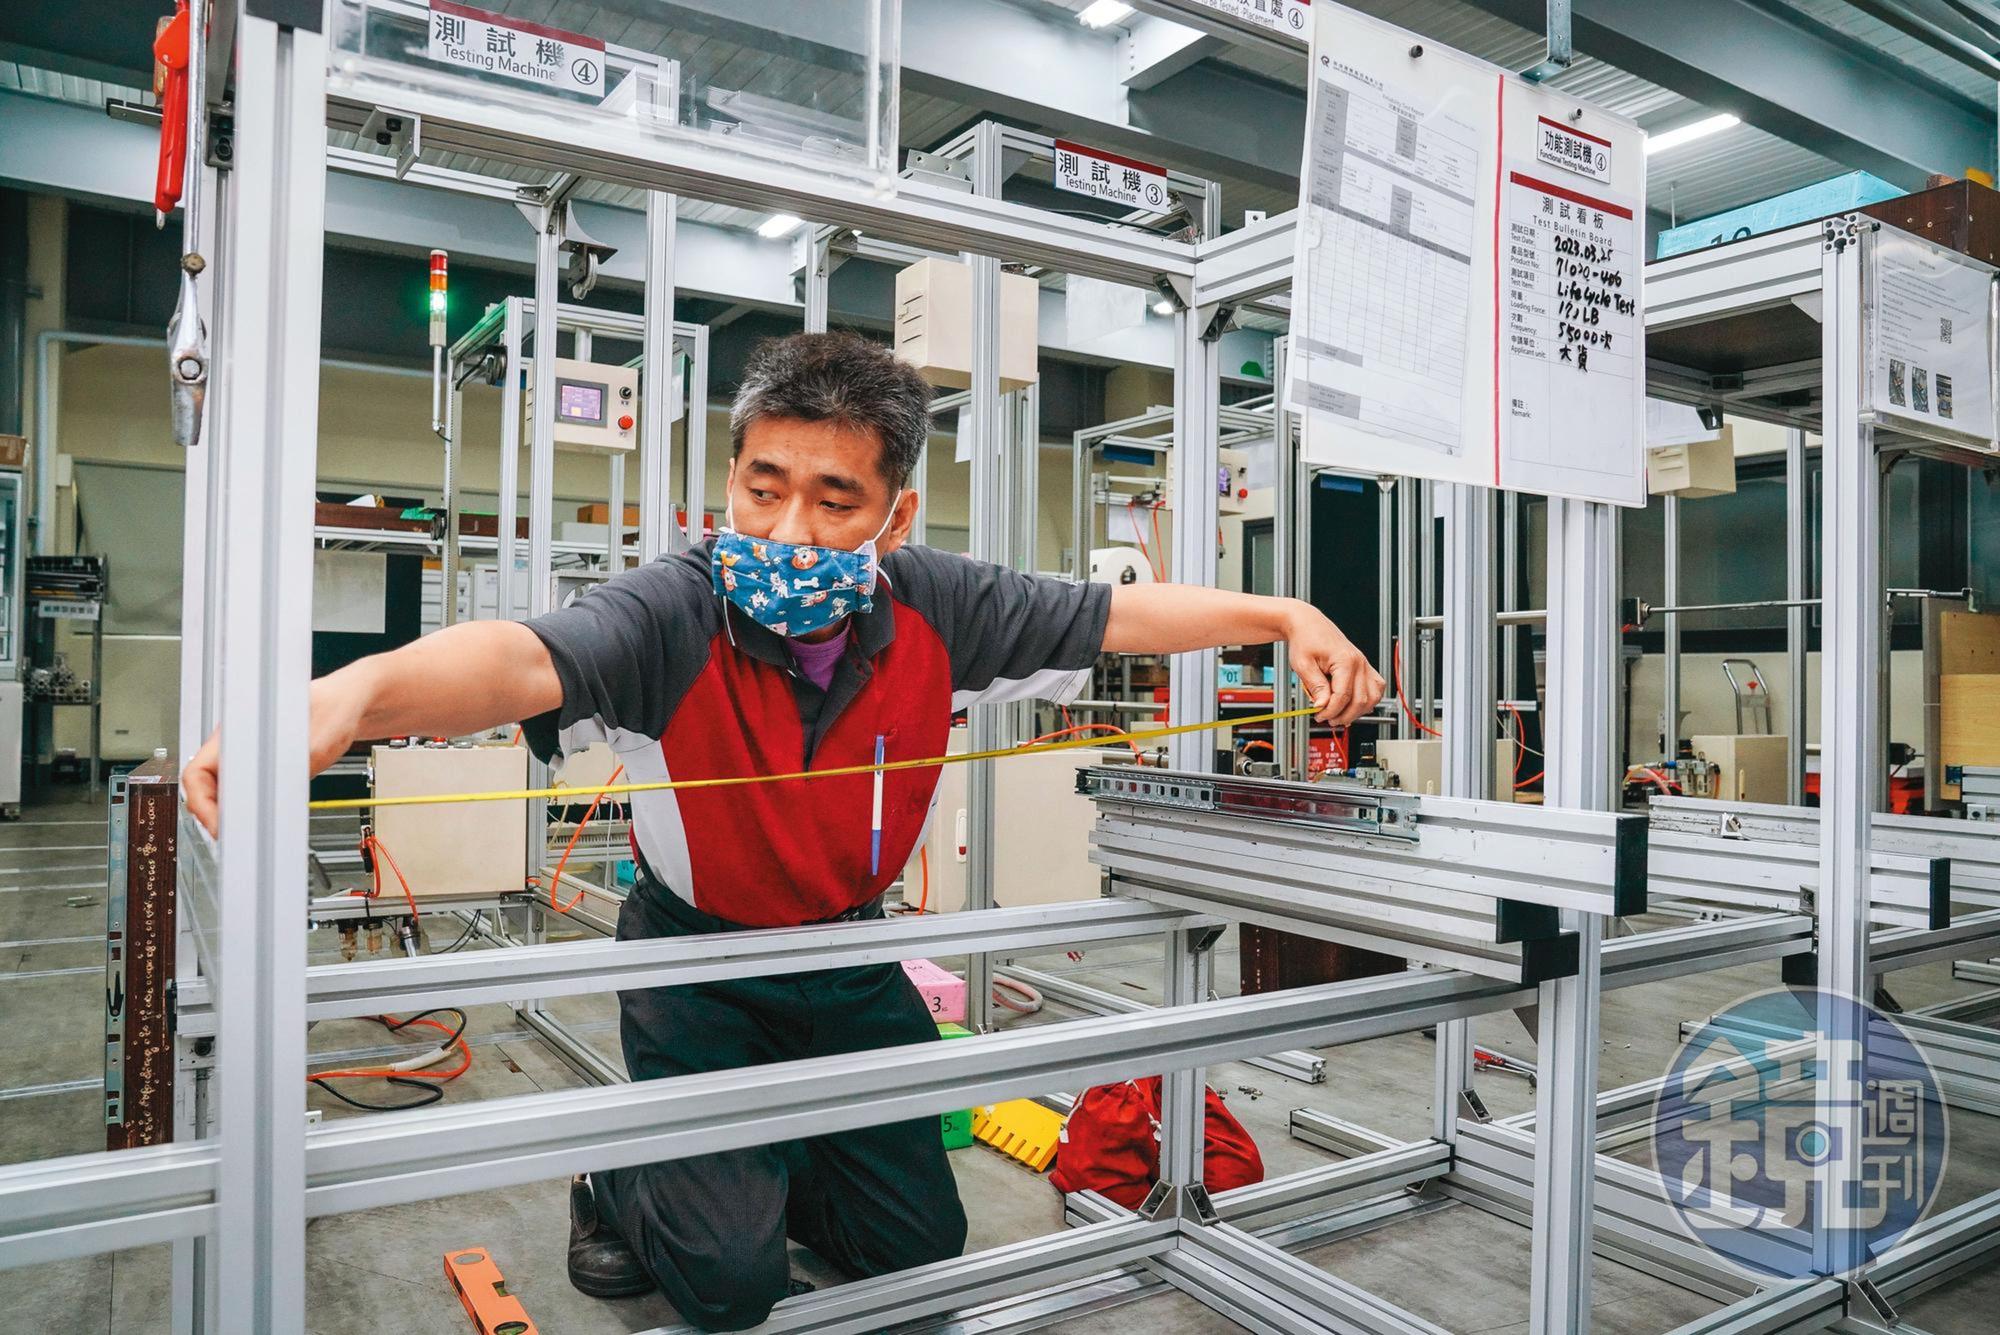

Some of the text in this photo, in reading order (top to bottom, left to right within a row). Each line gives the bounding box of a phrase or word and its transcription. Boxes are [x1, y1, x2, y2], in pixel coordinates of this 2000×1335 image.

[435, 14, 565, 68] 測試機
[443, 43, 557, 82] Testing Machine
[1545, 131, 1592, 164] 功能測試機
[1059, 152, 1141, 192] 測試機
[1563, 158, 1577, 171] Testing
[1578, 163, 1595, 175] Machine
[1065, 175, 1137, 203] Testing Machine
[1542, 196, 1604, 230] 測試看板
[1533, 215, 1612, 247] Test Bulletin Board
[1554, 235, 1614, 263] 2023.03.25
[1557, 281, 1582, 301] Life
[1614, 293, 1636, 317] Test
[1583, 306, 1600, 325] LB
[931, 996, 941, 1013] 3
[943, 1115, 953, 1133] 5
